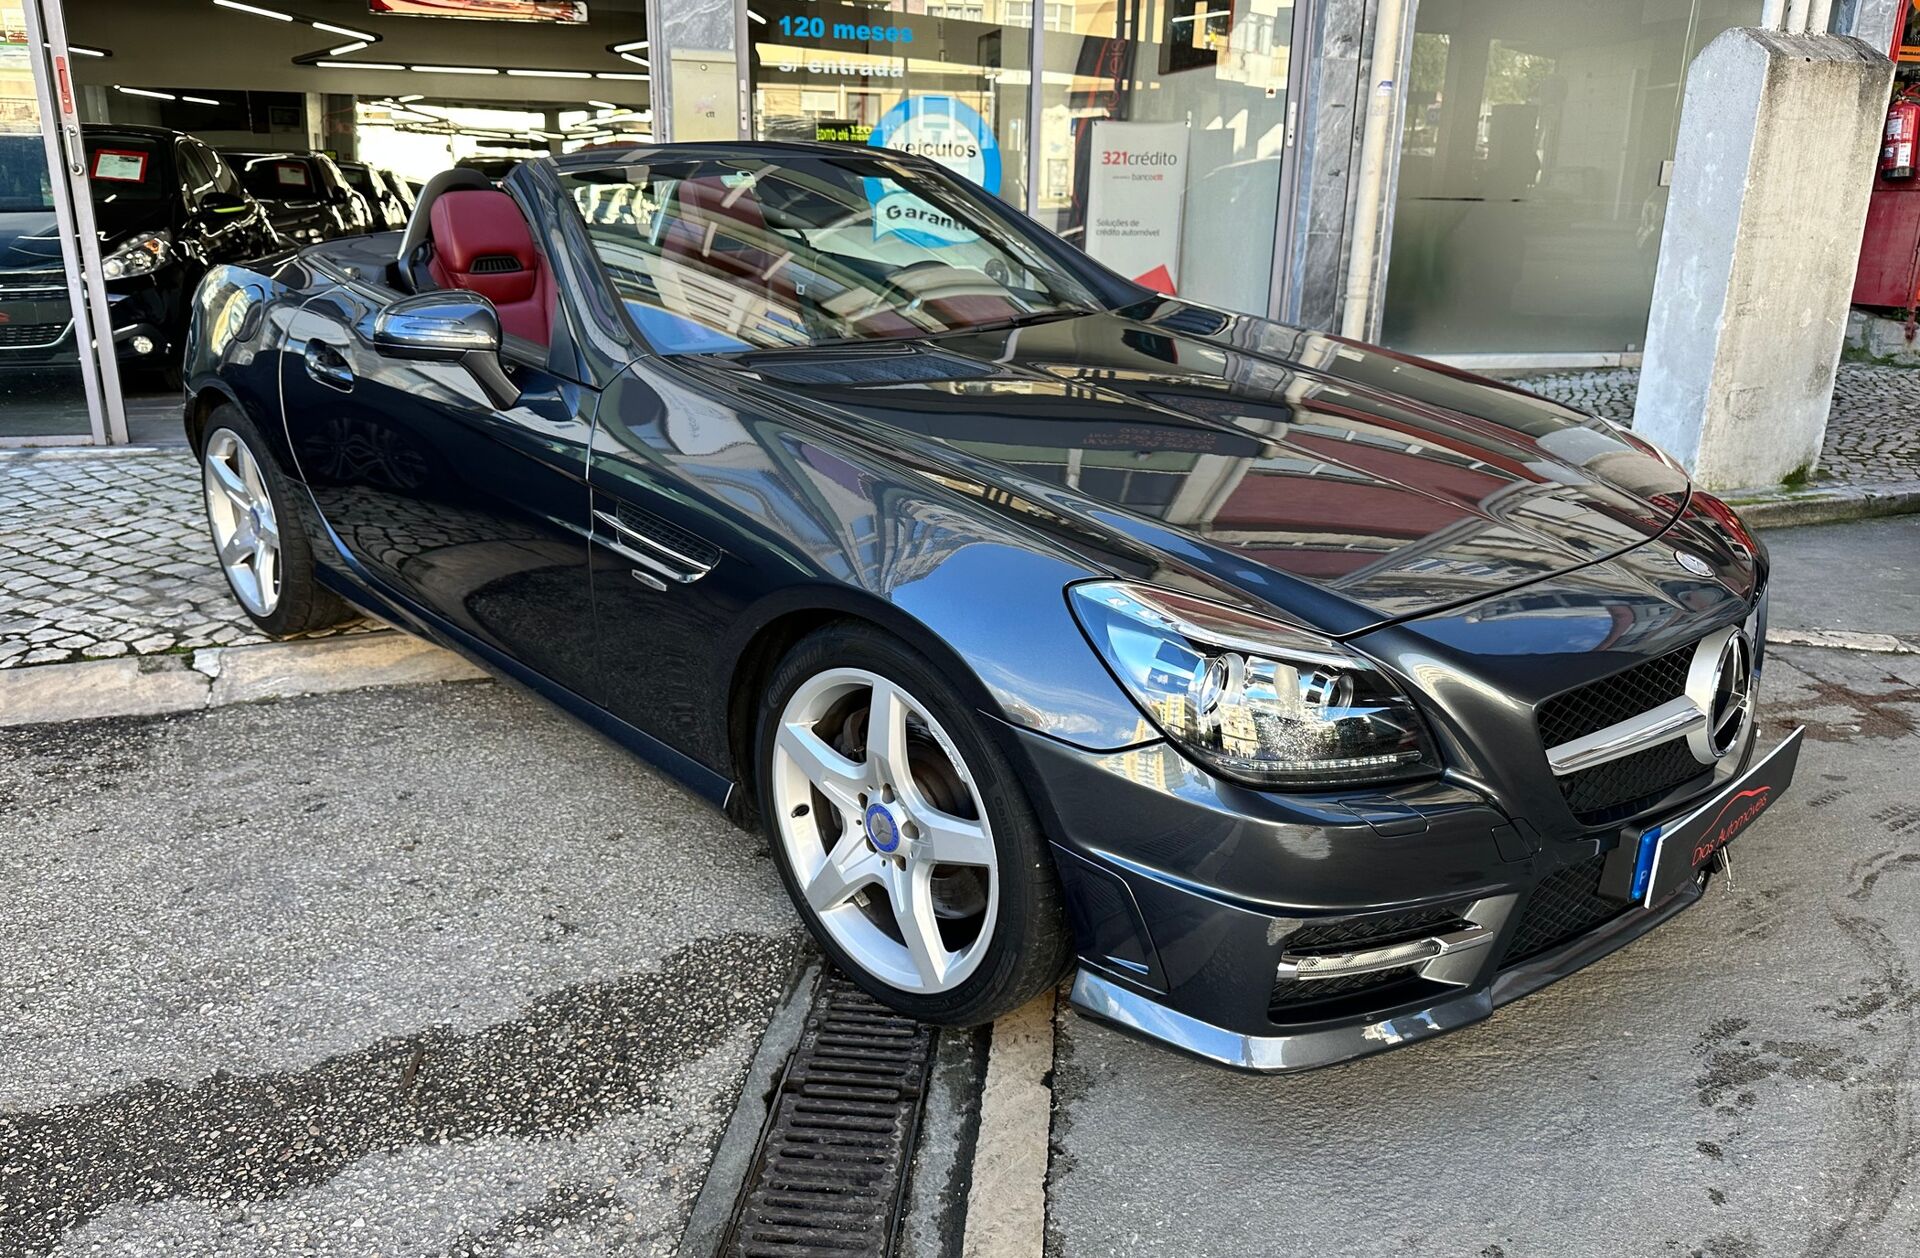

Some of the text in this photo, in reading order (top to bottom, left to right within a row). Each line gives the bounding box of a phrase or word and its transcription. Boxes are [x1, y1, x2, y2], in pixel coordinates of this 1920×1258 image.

[779, 15, 913, 43] 120 meses
[807, 57, 905, 78] entrada
[1101, 151, 1178, 166] 321crédito
[1096, 218, 1140, 228] Soluções de
[1096, 228, 1160, 237] crédito automóvel
[1638, 870, 1648, 885] P
